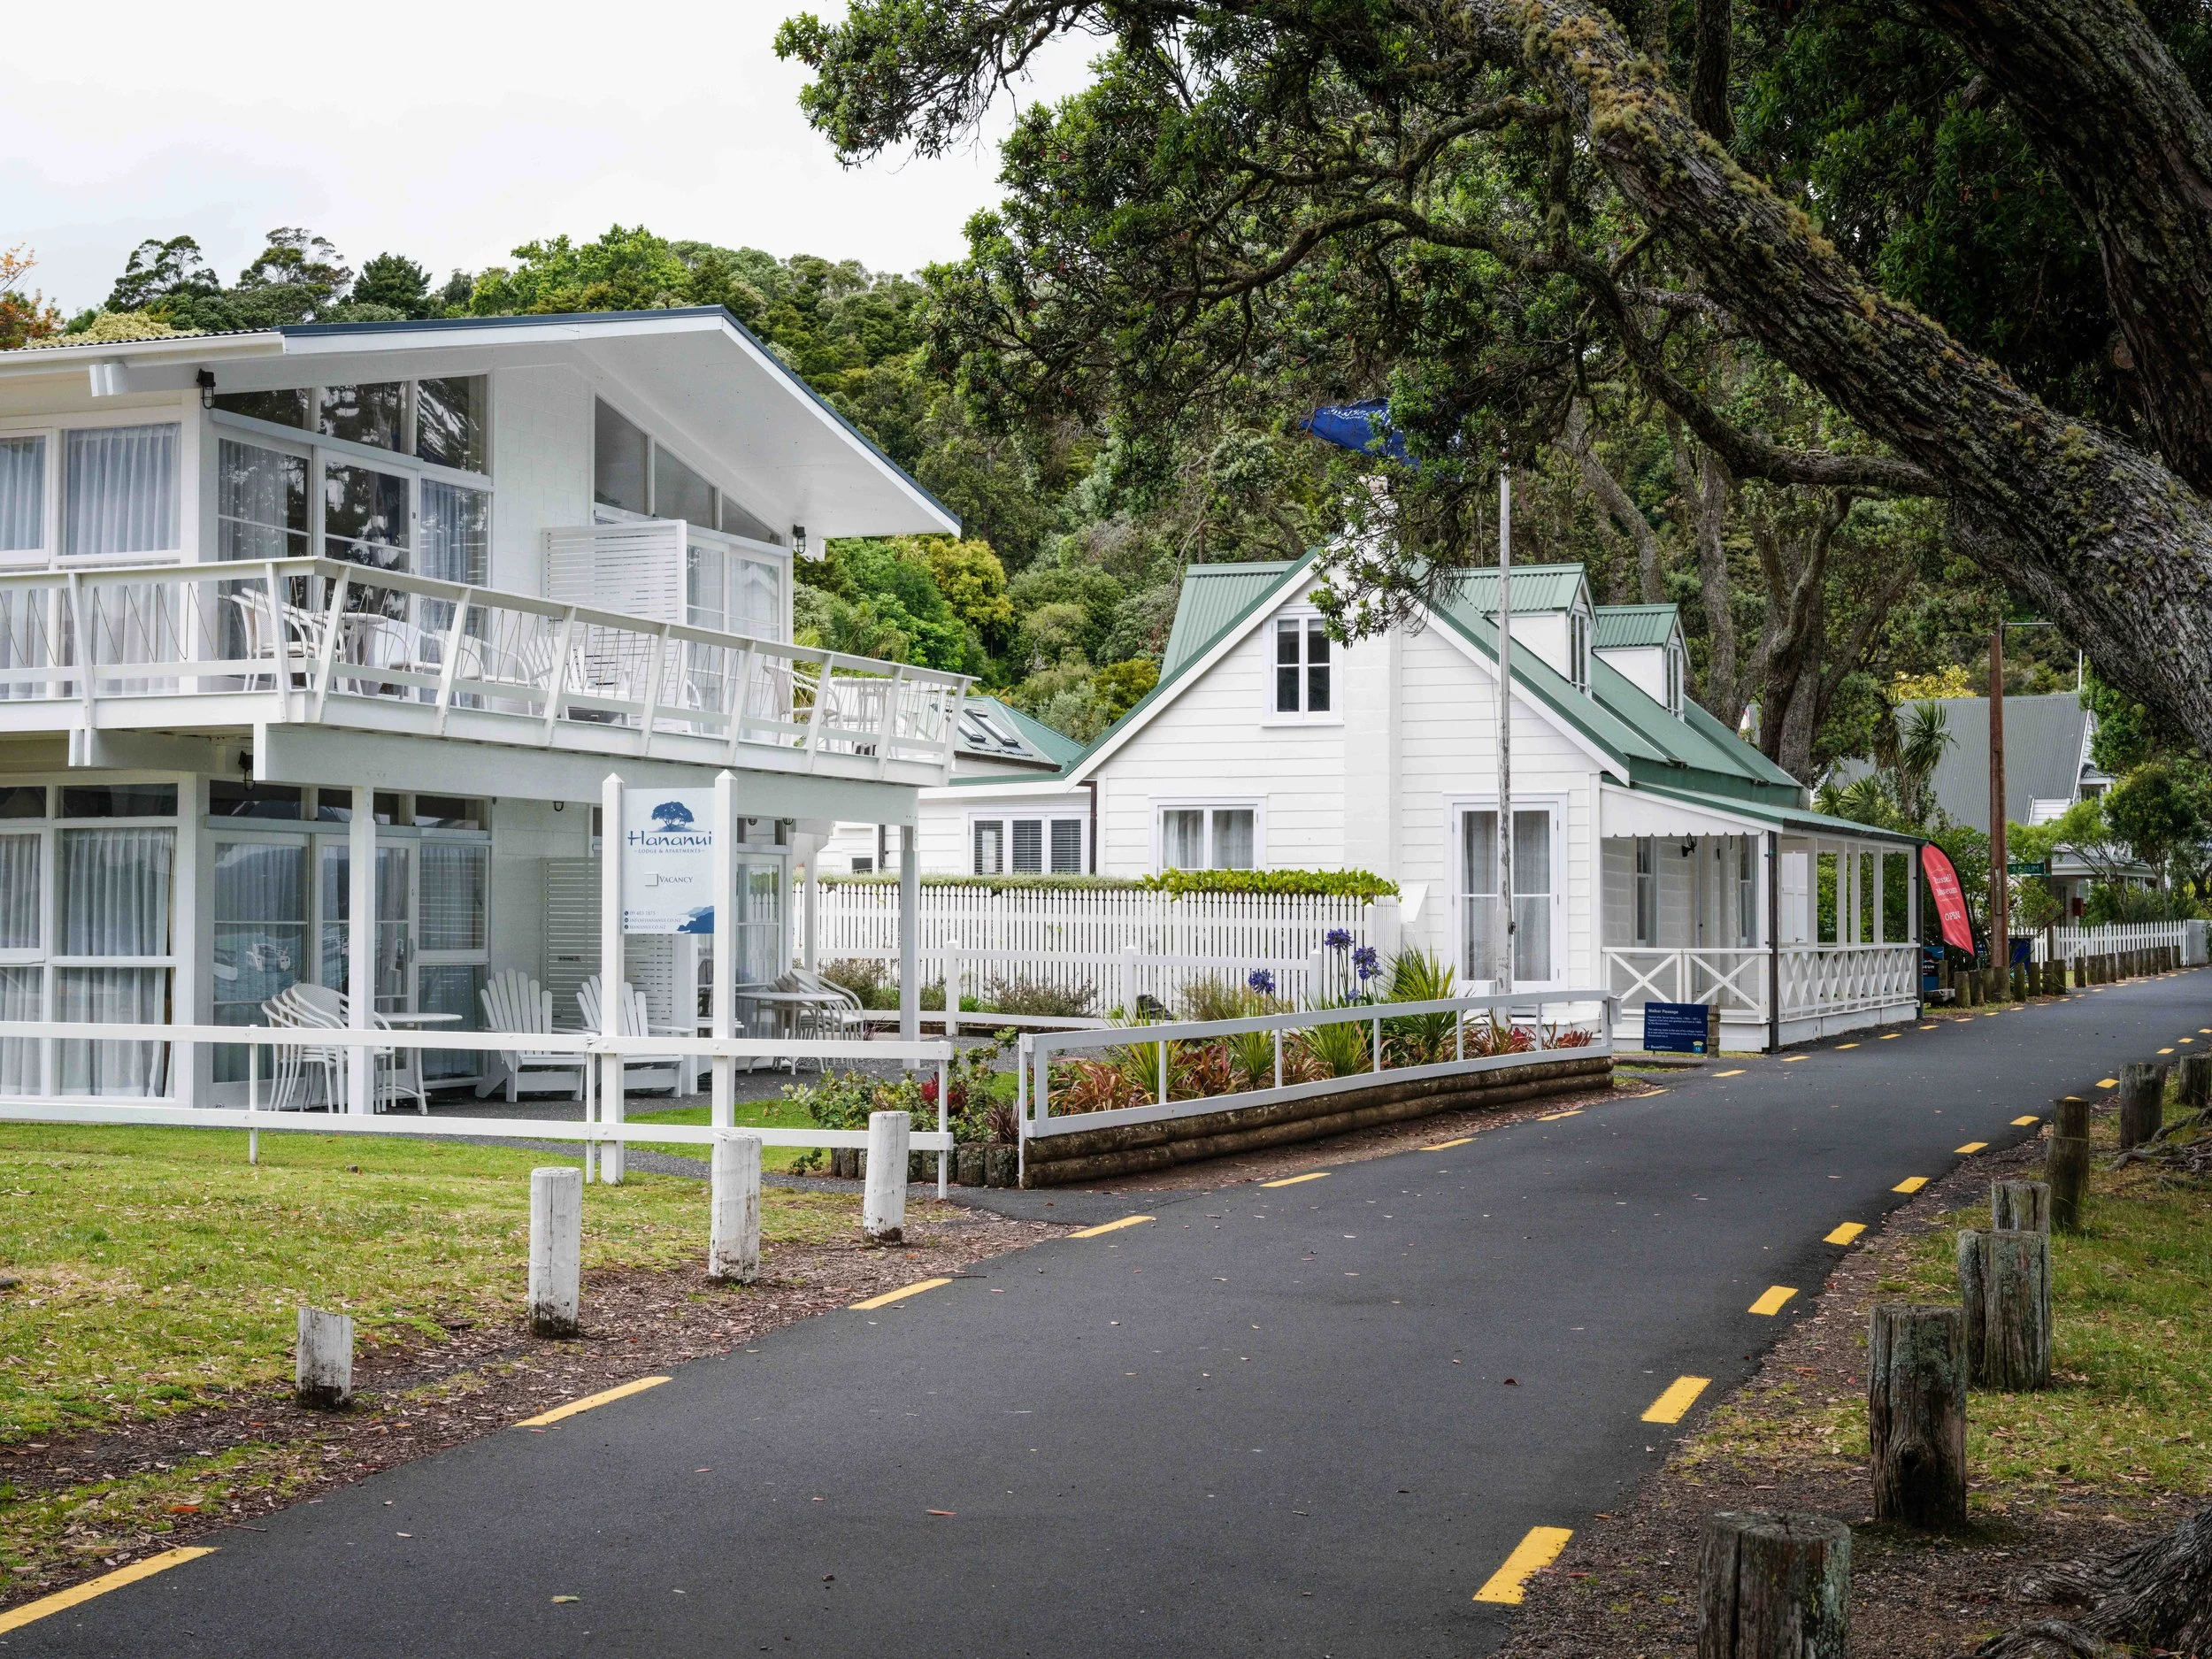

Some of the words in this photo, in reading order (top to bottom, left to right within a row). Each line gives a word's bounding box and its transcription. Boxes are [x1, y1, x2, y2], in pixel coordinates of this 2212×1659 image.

[627, 831, 711, 846] Hananui
[1936, 887, 1957, 896] Museum
[1945, 910, 1961, 921] OPEN
